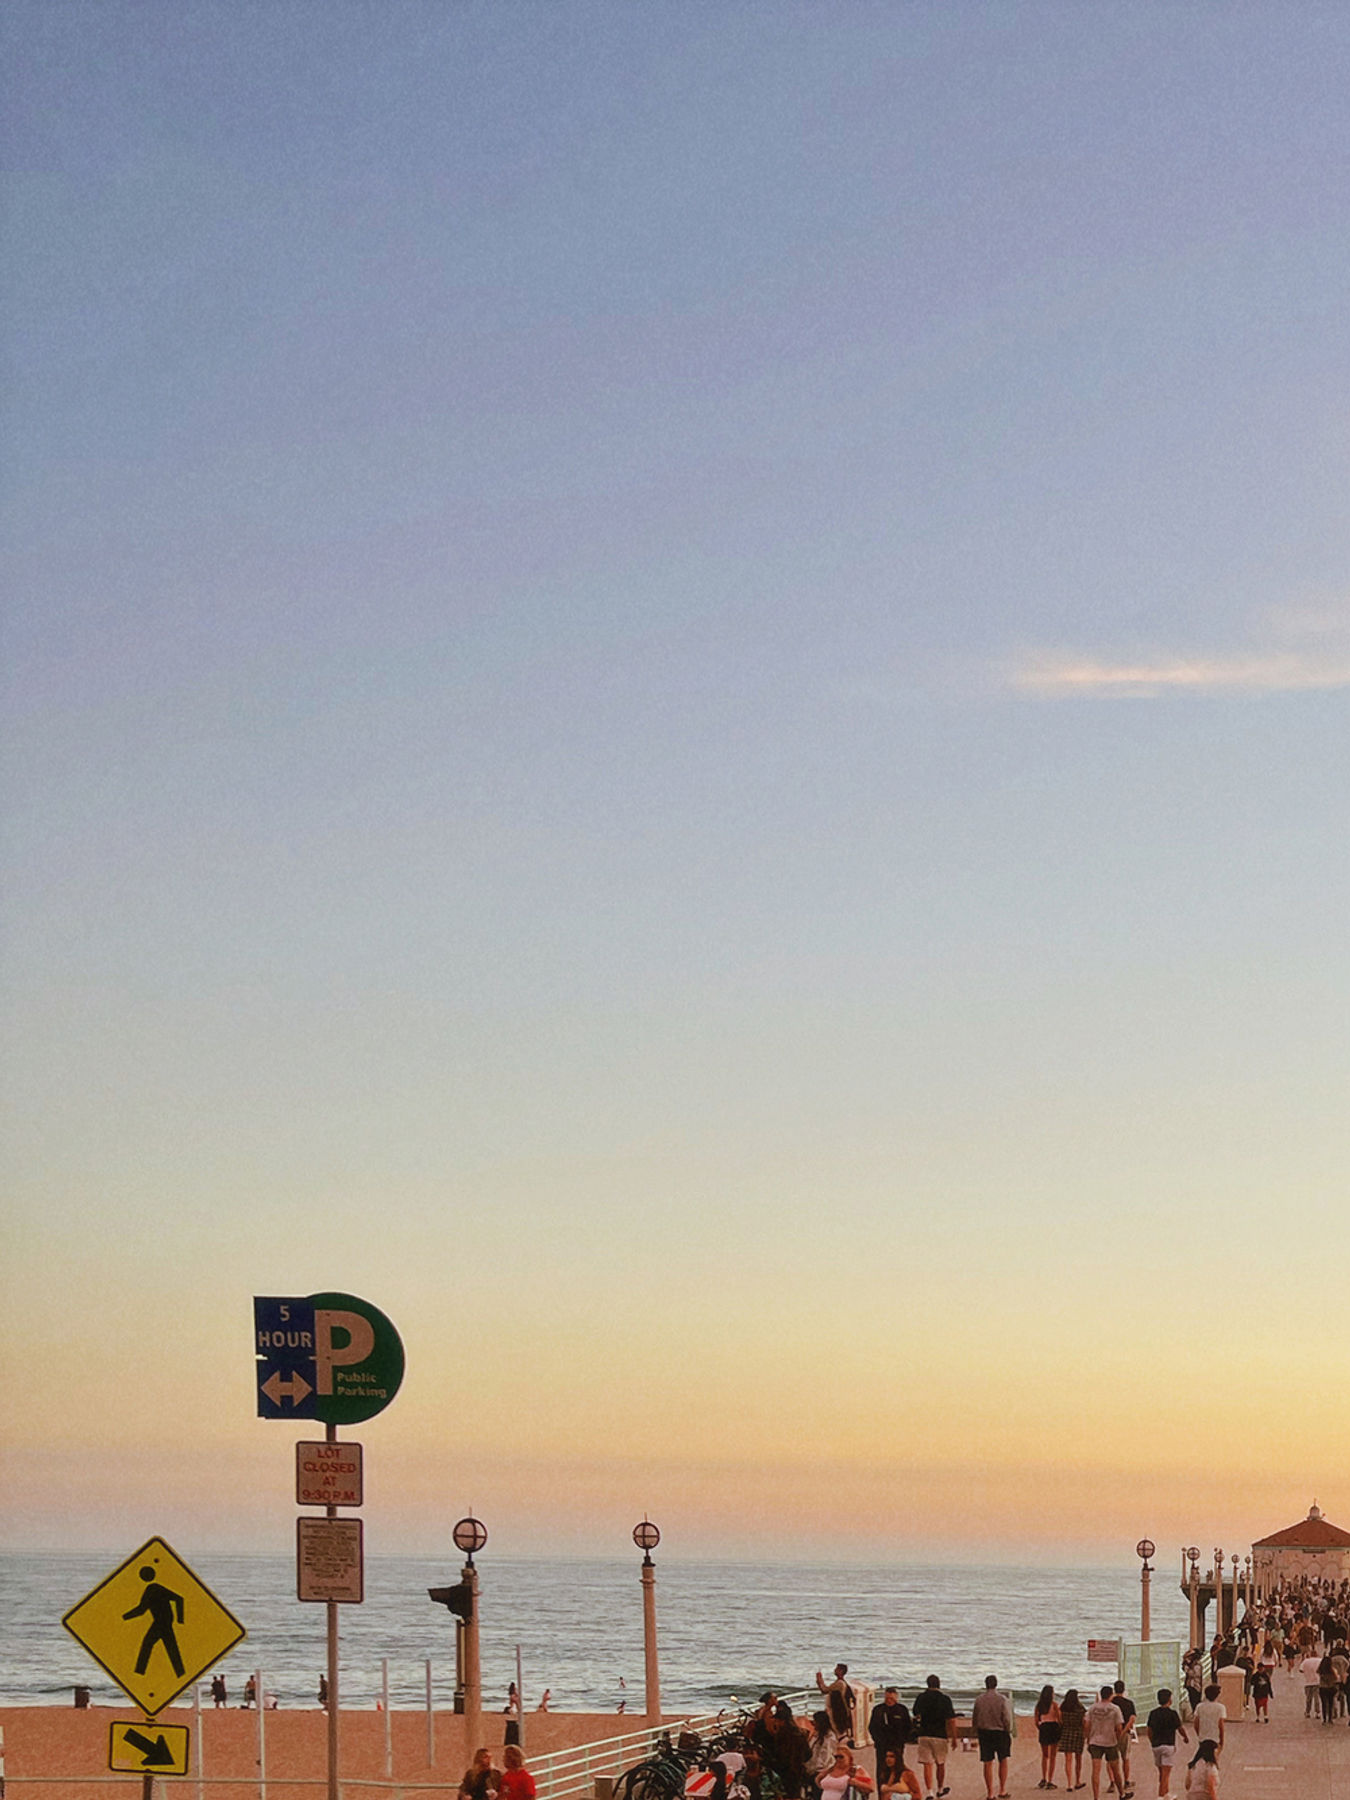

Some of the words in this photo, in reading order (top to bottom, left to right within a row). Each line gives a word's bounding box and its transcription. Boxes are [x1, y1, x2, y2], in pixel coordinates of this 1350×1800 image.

[280, 1305, 290, 1321] 5
[258, 1330, 313, 1348] HOUR
[314, 1309, 375, 1395] P
[337, 1372, 377, 1383] Public
[337, 1386, 387, 1399] Parking
[317, 1447, 342, 1459] LOT
[303, 1461, 357, 1473] CLOSED
[322, 1475, 337, 1487] AT
[302, 1488, 331, 1501] 9:30
